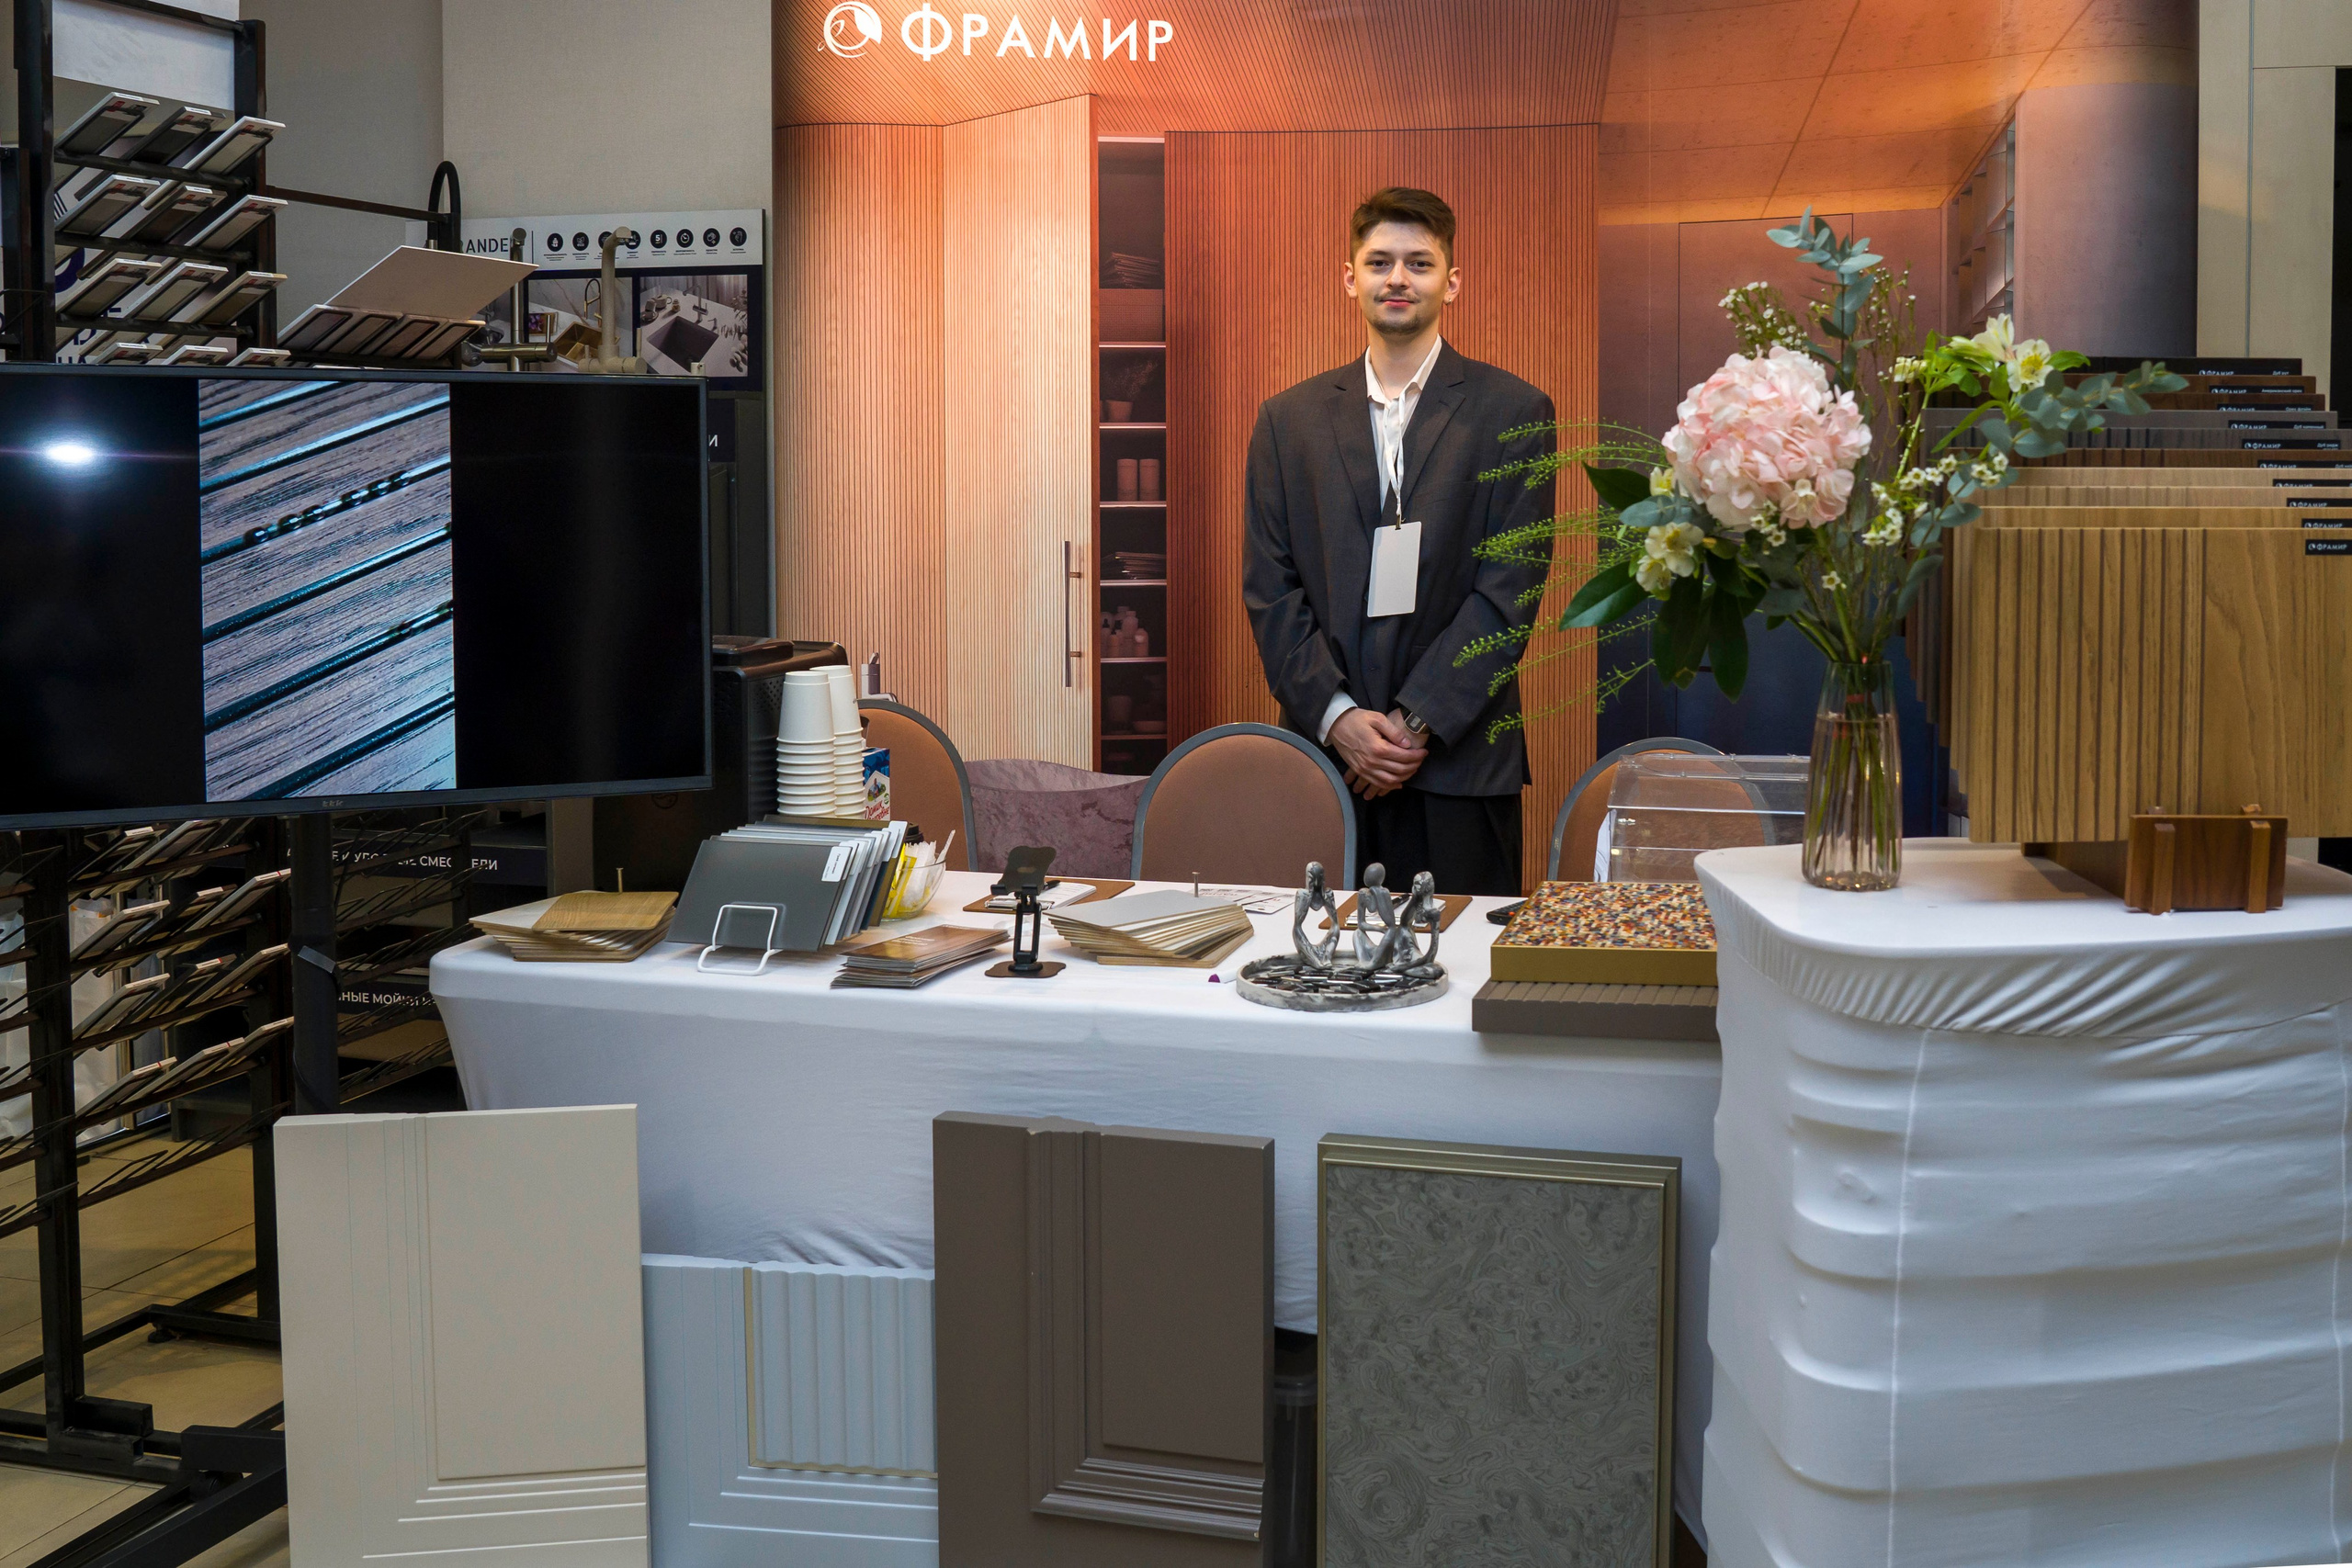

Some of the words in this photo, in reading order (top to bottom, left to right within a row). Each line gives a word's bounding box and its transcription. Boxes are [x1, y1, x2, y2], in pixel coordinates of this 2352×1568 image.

[900, 2, 1174, 62] ФРАМИР
[466, 238, 508, 254] ANDE
[2316, 543, 2347, 551] ФРАМИР
[419, 855, 498, 871] СМЕСЕЛИ
